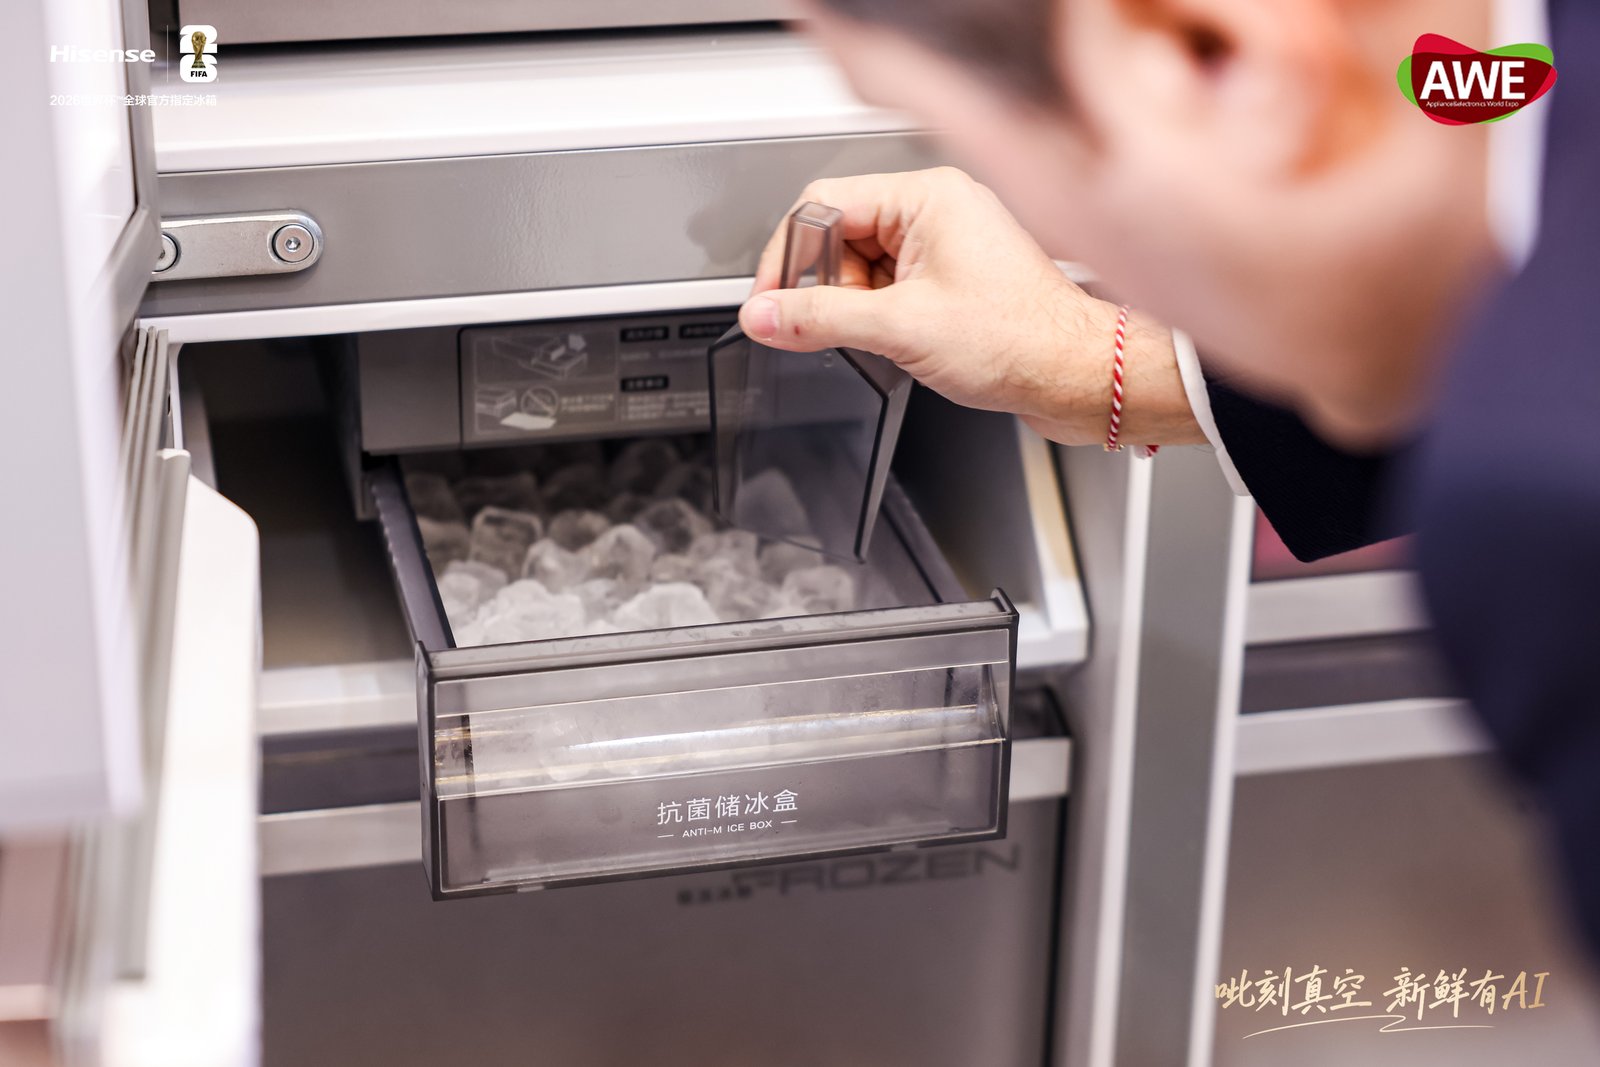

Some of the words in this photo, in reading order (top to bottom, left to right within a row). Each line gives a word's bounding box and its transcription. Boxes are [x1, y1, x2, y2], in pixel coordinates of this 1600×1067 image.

[657, 789, 799, 826] 抗菌储冰盒
[682, 826, 722, 838] ANTI-M
[727, 823, 745, 833] ICE
[749, 820, 773, 830] BOX
